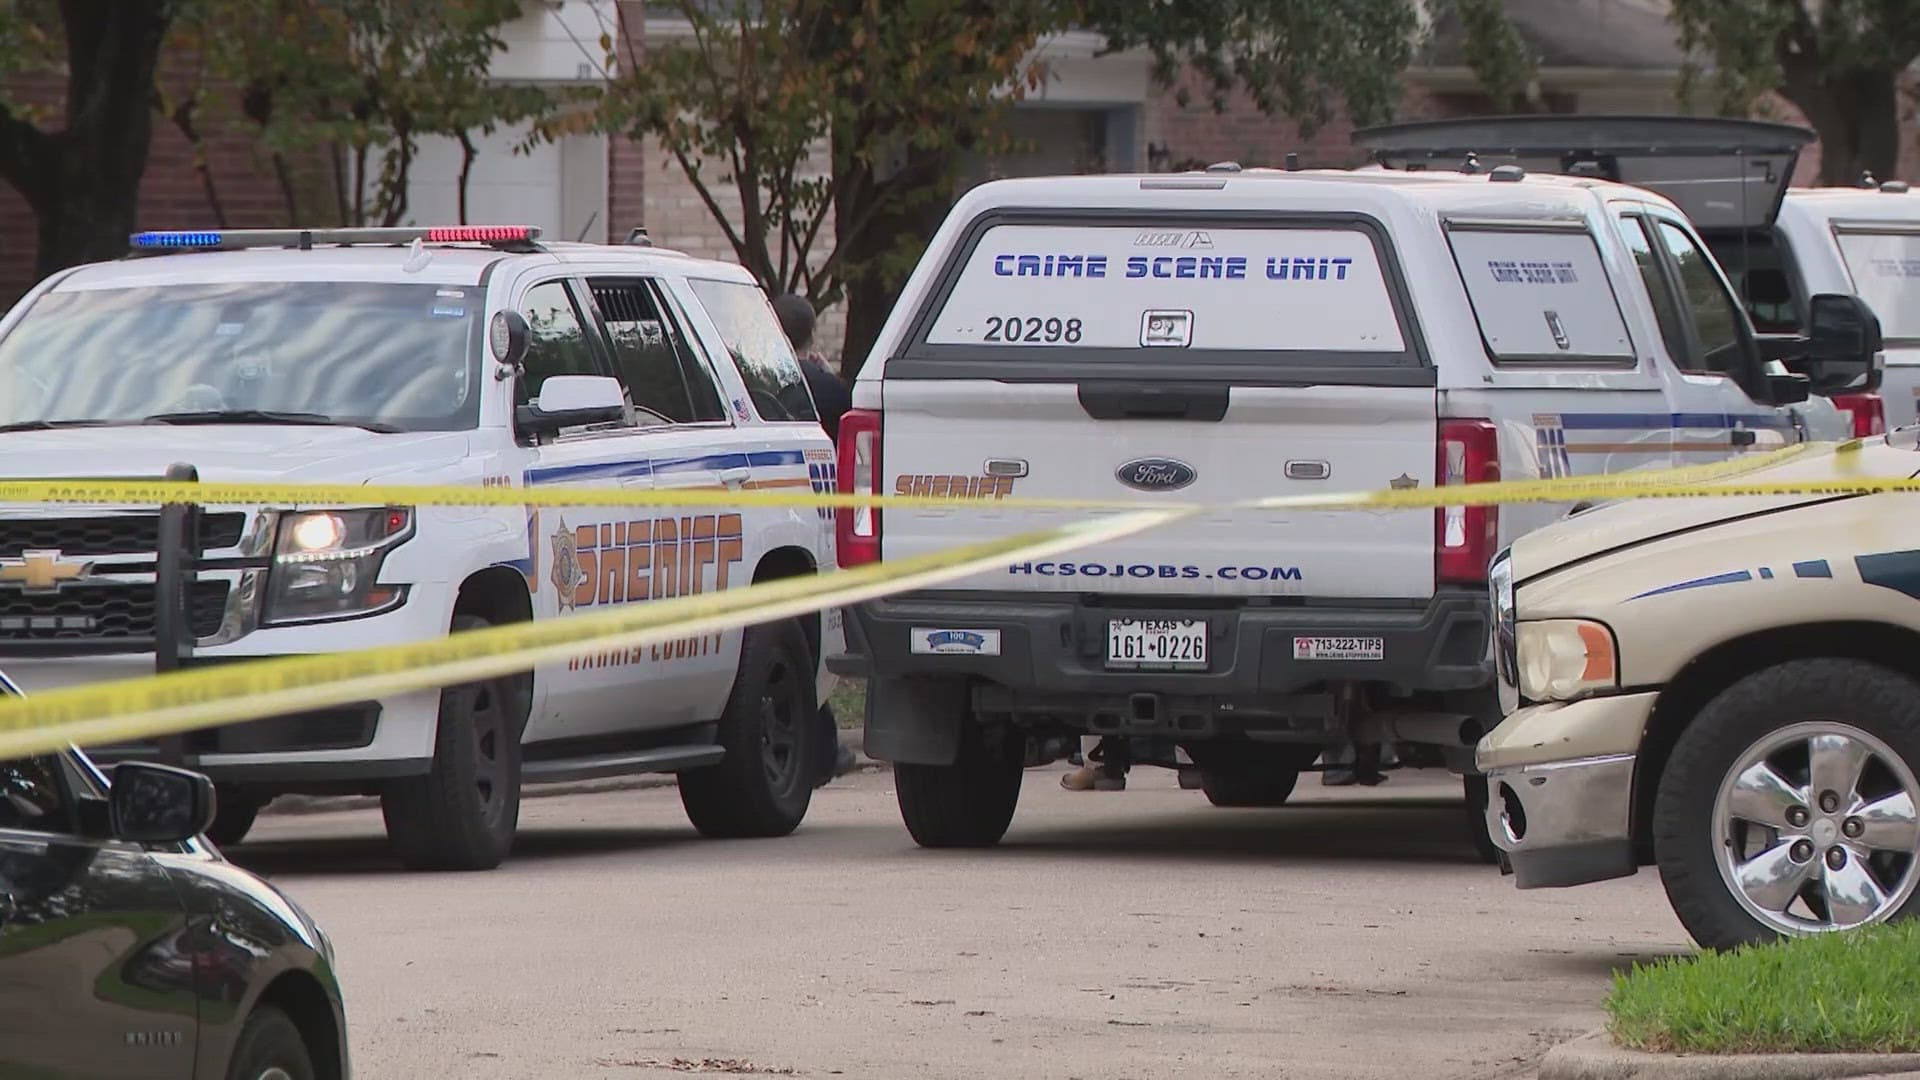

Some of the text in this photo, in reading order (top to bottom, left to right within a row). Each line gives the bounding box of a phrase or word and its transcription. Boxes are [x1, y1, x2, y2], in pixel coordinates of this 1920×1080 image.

[994, 255, 1352, 280] CRIME SCENE UNIT
[983, 316, 1083, 343] 20298
[1133, 464, 1178, 485] Ford
[575, 513, 744, 607] SHERIFF
[1008, 562, 1304, 581] HCSOJOBS.COM
[1139, 619, 1178, 630] TEXAS
[950, 632, 965, 641] 100
[1314, 639, 1382, 651] 713-222-TIPS
